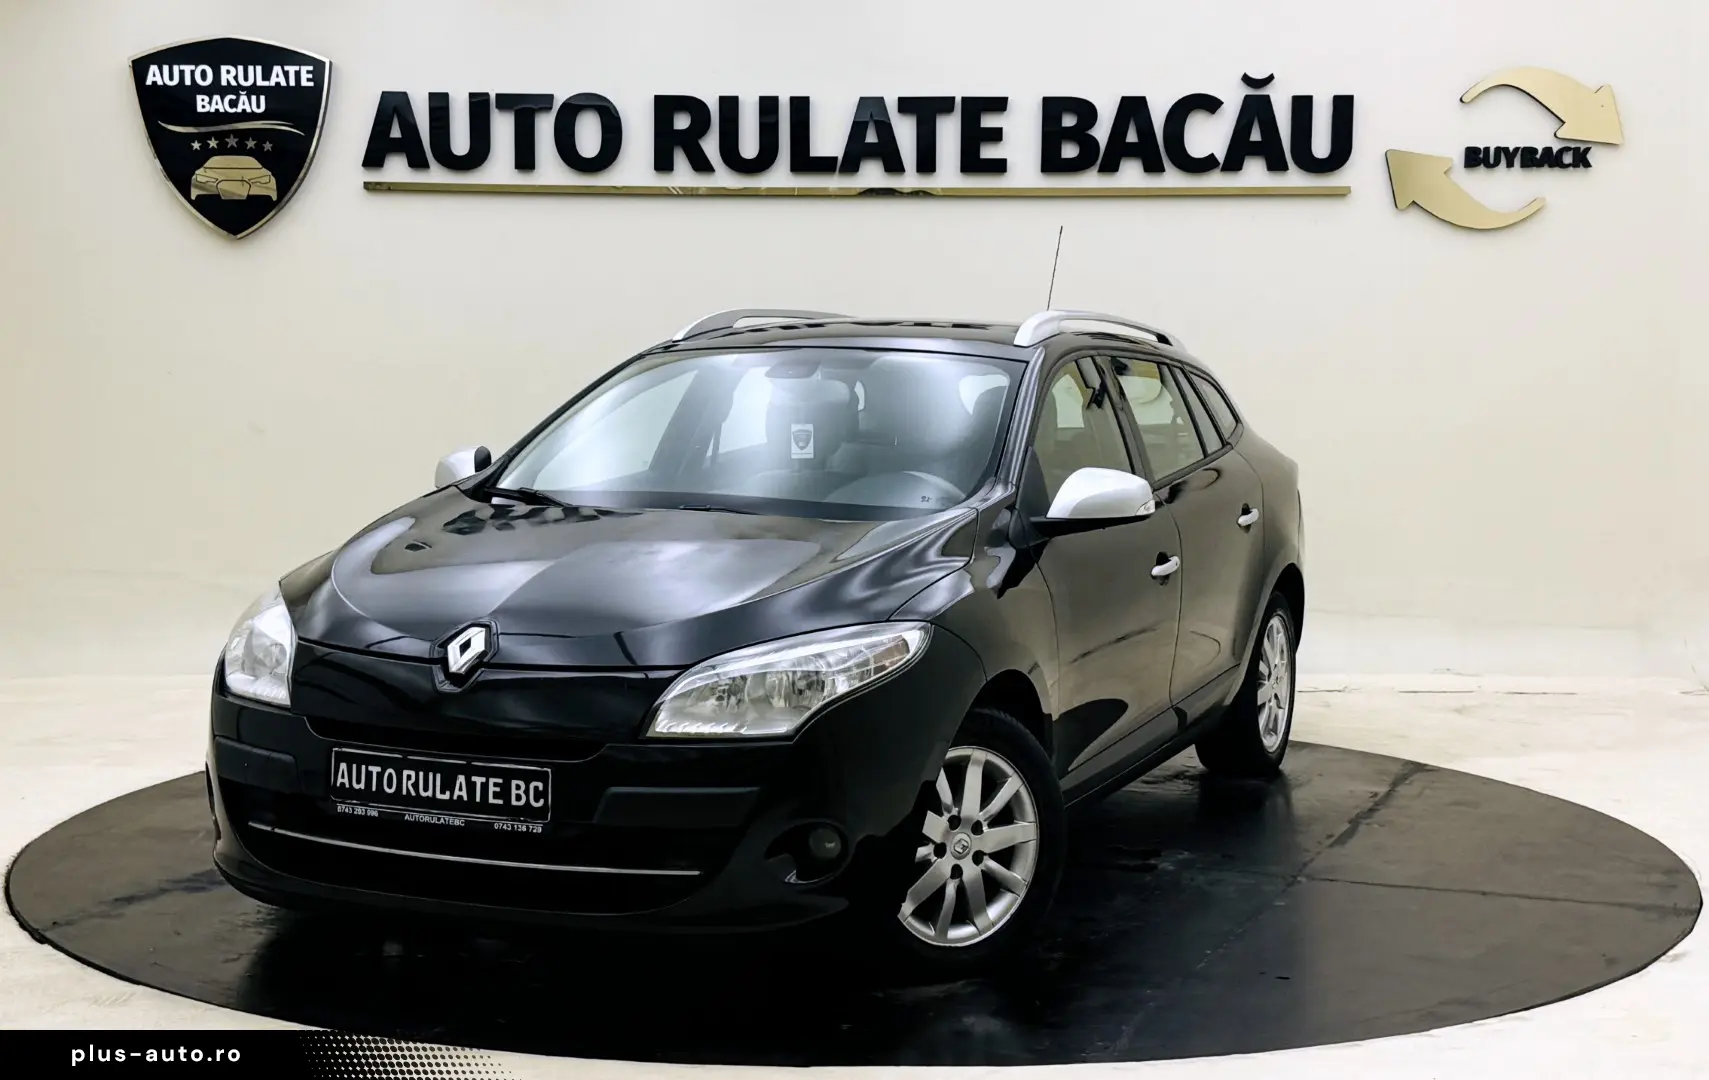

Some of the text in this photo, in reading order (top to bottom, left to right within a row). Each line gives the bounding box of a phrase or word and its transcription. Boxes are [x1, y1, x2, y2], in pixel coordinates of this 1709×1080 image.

[146, 64, 314, 87] AUTO RULATE
[196, 91, 266, 114] BACĂU
[361, 72, 1354, 174] AUTO RULATE BACĂU
[1463, 146, 1592, 168] BUYBACK
[336, 762, 545, 808] AUTO RULATE BC
[404, 814, 465, 826] AUTORULATEBC
